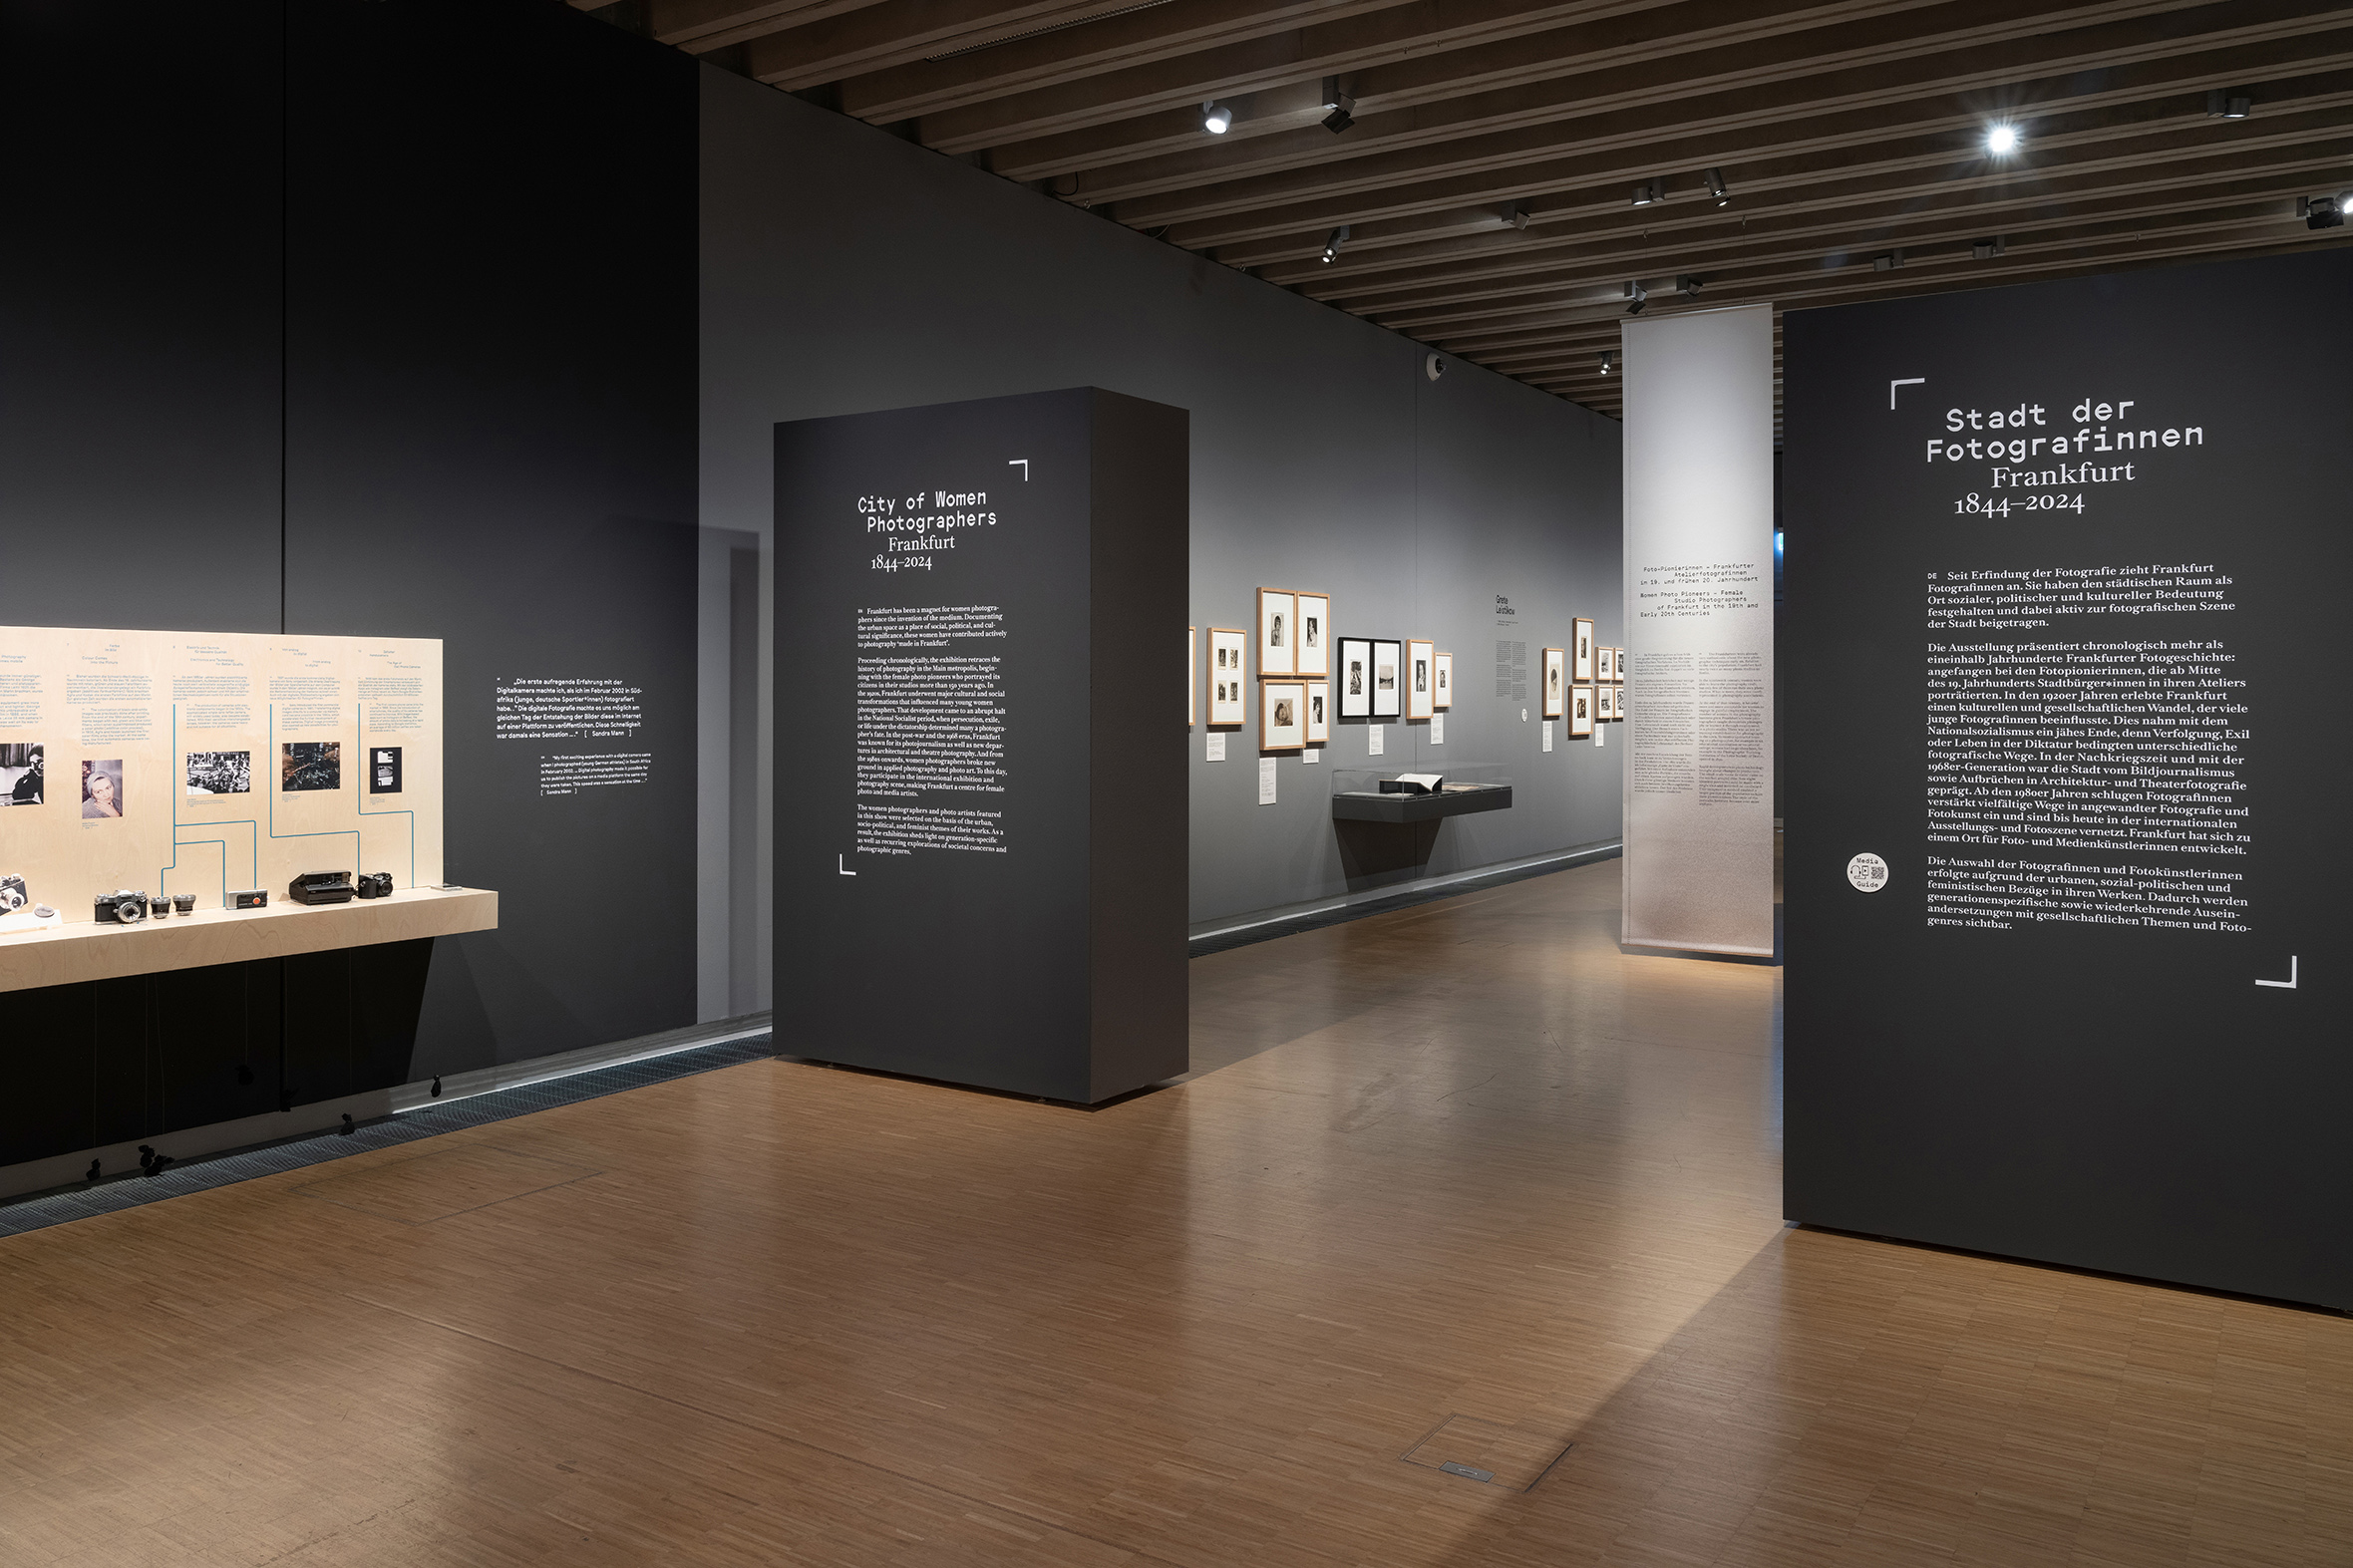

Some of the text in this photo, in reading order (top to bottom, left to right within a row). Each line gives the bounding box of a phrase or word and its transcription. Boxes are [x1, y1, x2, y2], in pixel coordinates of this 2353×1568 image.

[1946, 398, 2134, 432] Stadt der
[1927, 426, 2202, 464] Fotografinnen
[1991, 462, 2136, 488] Frankfurt
[857, 490, 986, 514] City of Women
[1954, 492, 2085, 518] 1844–2024
[867, 510, 996, 533] Photographers
[888, 534, 955, 551] Frankfurt
[871, 554, 932, 572] 1844–2024
[1947, 563, 2213, 580] Seit Erfindung der Fotografie zieht Frankfurt
[1928, 583, 2004, 594] Fotografinnen
[2025, 581, 2042, 590] Sie
[2045, 580, 2079, 589] haben
[2082, 579, 2103, 588] den
[2106, 577, 2173, 588] städtischen
[2215, 575, 2232, 584] als
[1947, 595, 1994, 604] sozialer,
[1996, 593, 2058, 605] politischer
[2061, 592, 2083, 601] und
[2087, 590, 2153, 600] kultureller
[2156, 589, 2224, 600] Bedeutung
[1928, 607, 1994, 618] festgehalten
[1997, 606, 2018, 615] und
[2021, 605, 2052, 614] dabei
[2055, 604, 2084, 614] aktiv
[2109, 602, 2196, 614] fotografischen
[2199, 601, 2235, 610] Szene
[1948, 619, 1976, 628] Stadt
[1979, 618, 2049, 629] beigetragen.
[1928, 856, 2242, 880] Die Auswahl der Fotografinnen und Fotokünstlerinnen
[1927, 868, 2230, 892] erfolgte aufgrund der urbanen, sozial-politischen und
[1928, 880, 2247, 906] feministischen Bezüge in ihren Werken. Dadurch werden
[1927, 917, 2012, 929] genres sichtbar.
